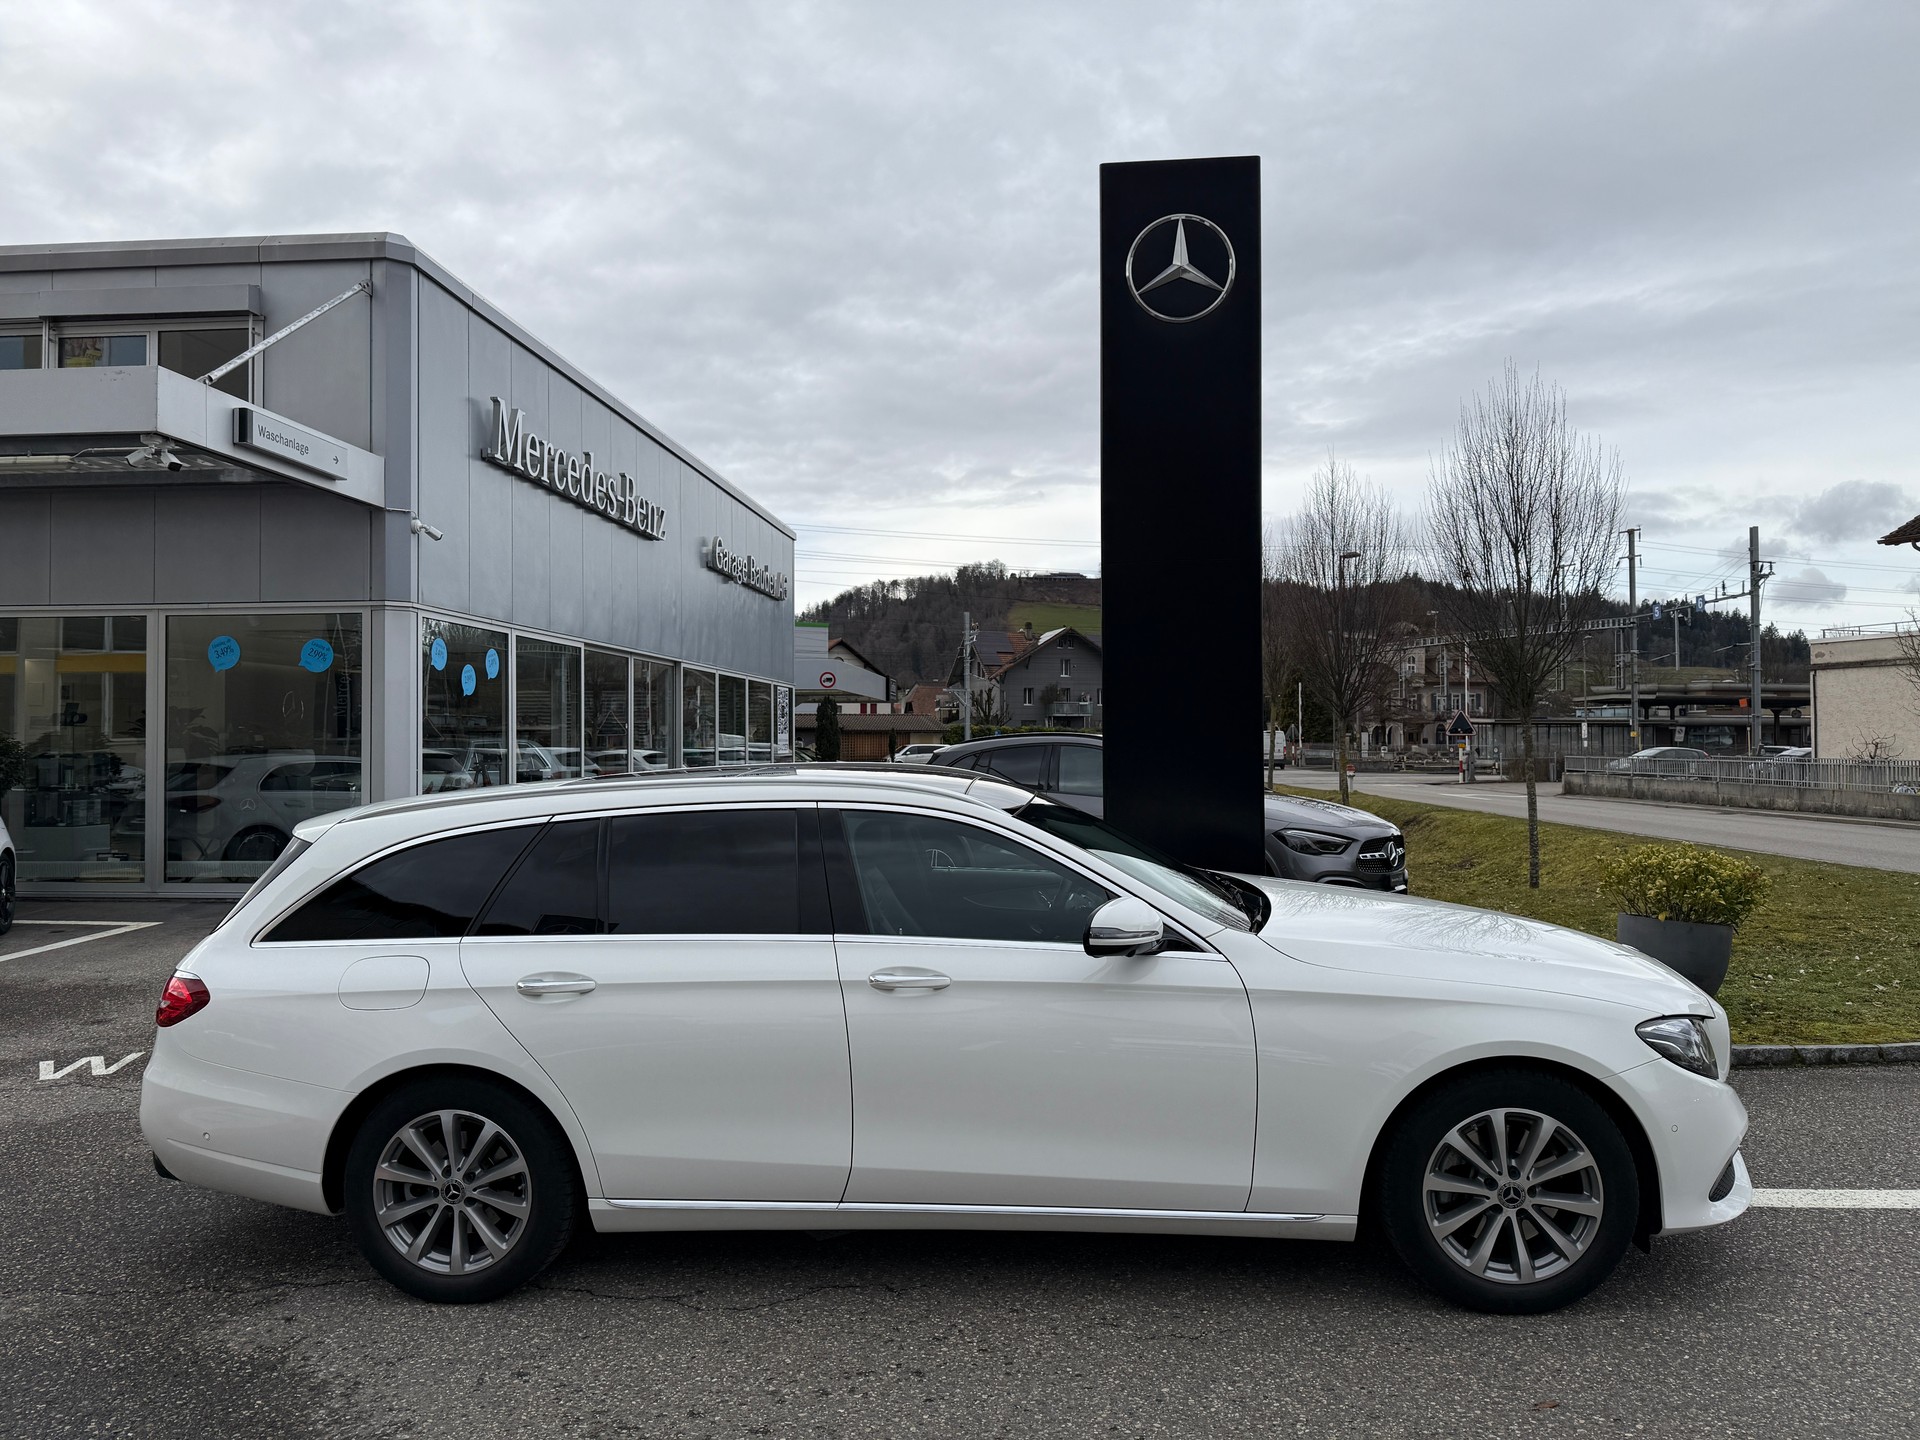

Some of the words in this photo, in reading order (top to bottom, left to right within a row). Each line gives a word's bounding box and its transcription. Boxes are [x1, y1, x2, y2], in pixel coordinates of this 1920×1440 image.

[257, 424, 309, 455] Waschanlage
[491, 397, 667, 541] Mercedes-Benz
[714, 536, 748, 584] Garage
